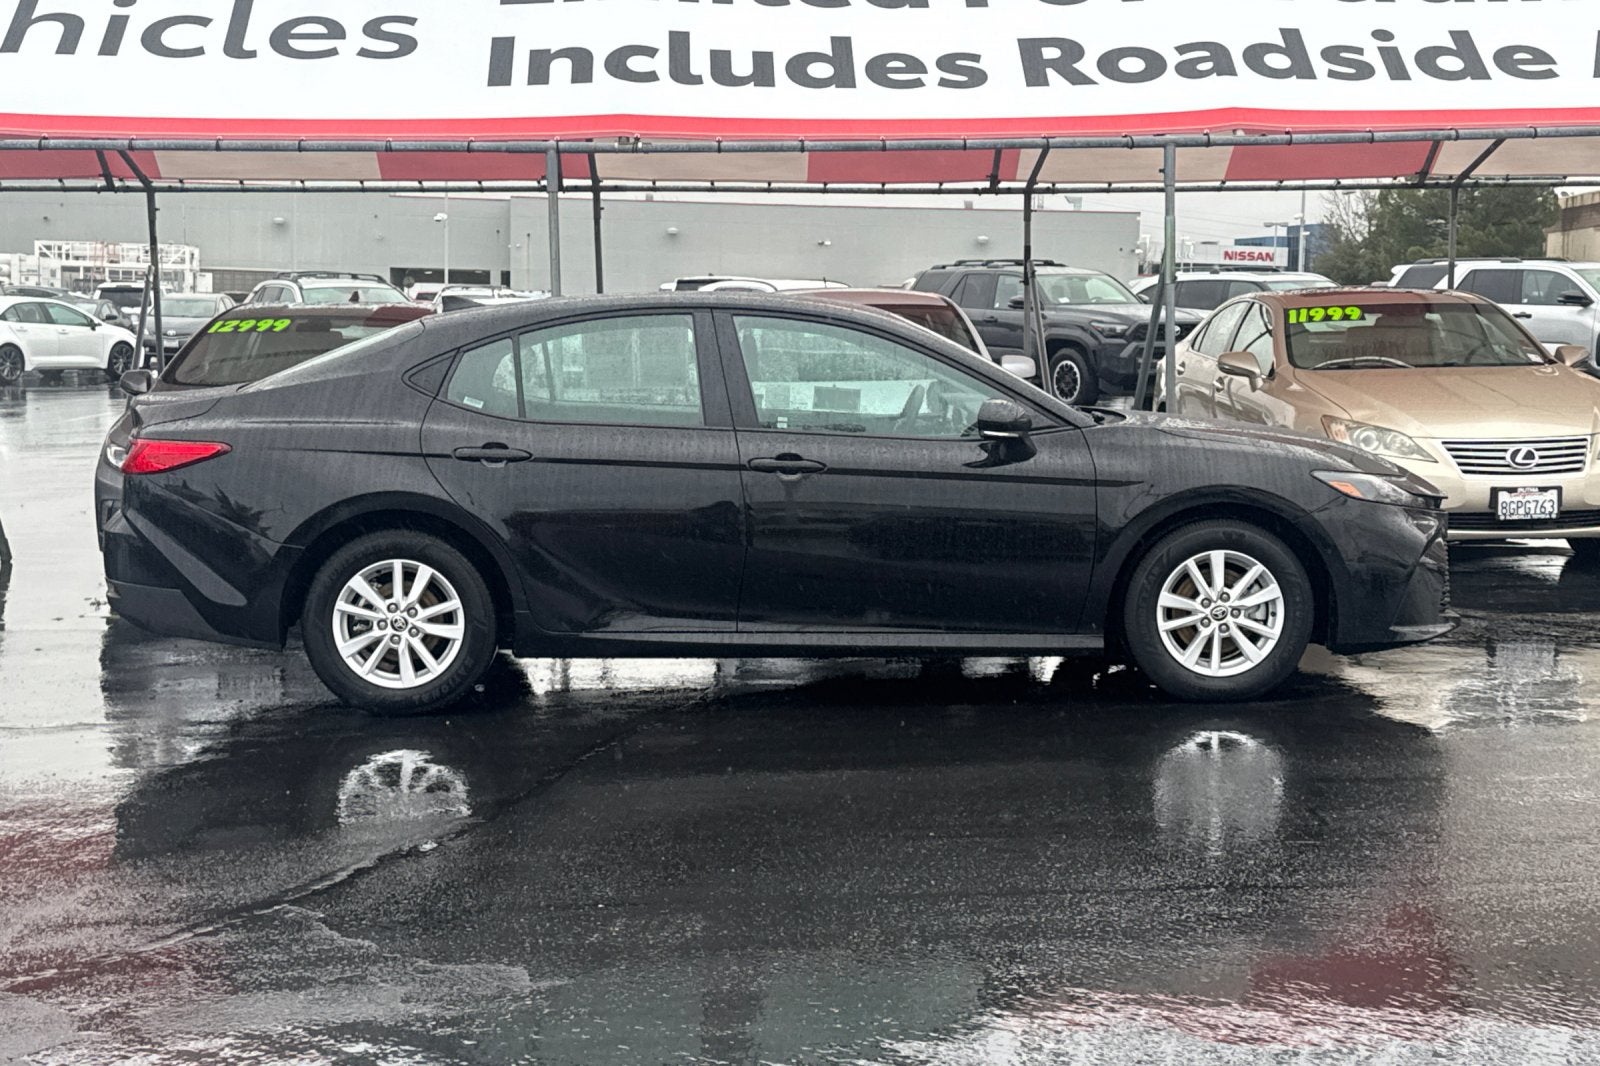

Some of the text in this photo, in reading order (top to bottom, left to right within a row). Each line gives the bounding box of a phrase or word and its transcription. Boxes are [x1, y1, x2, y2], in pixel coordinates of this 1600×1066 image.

[487, 30, 989, 89] Includes
[1016, 27, 1560, 88] Roadside
[1223, 250, 1275, 262] NISSAN
[1288, 305, 1362, 324] 11999
[207, 318, 291, 333] 12999
[1500, 499, 1555, 516] 8GPG763
